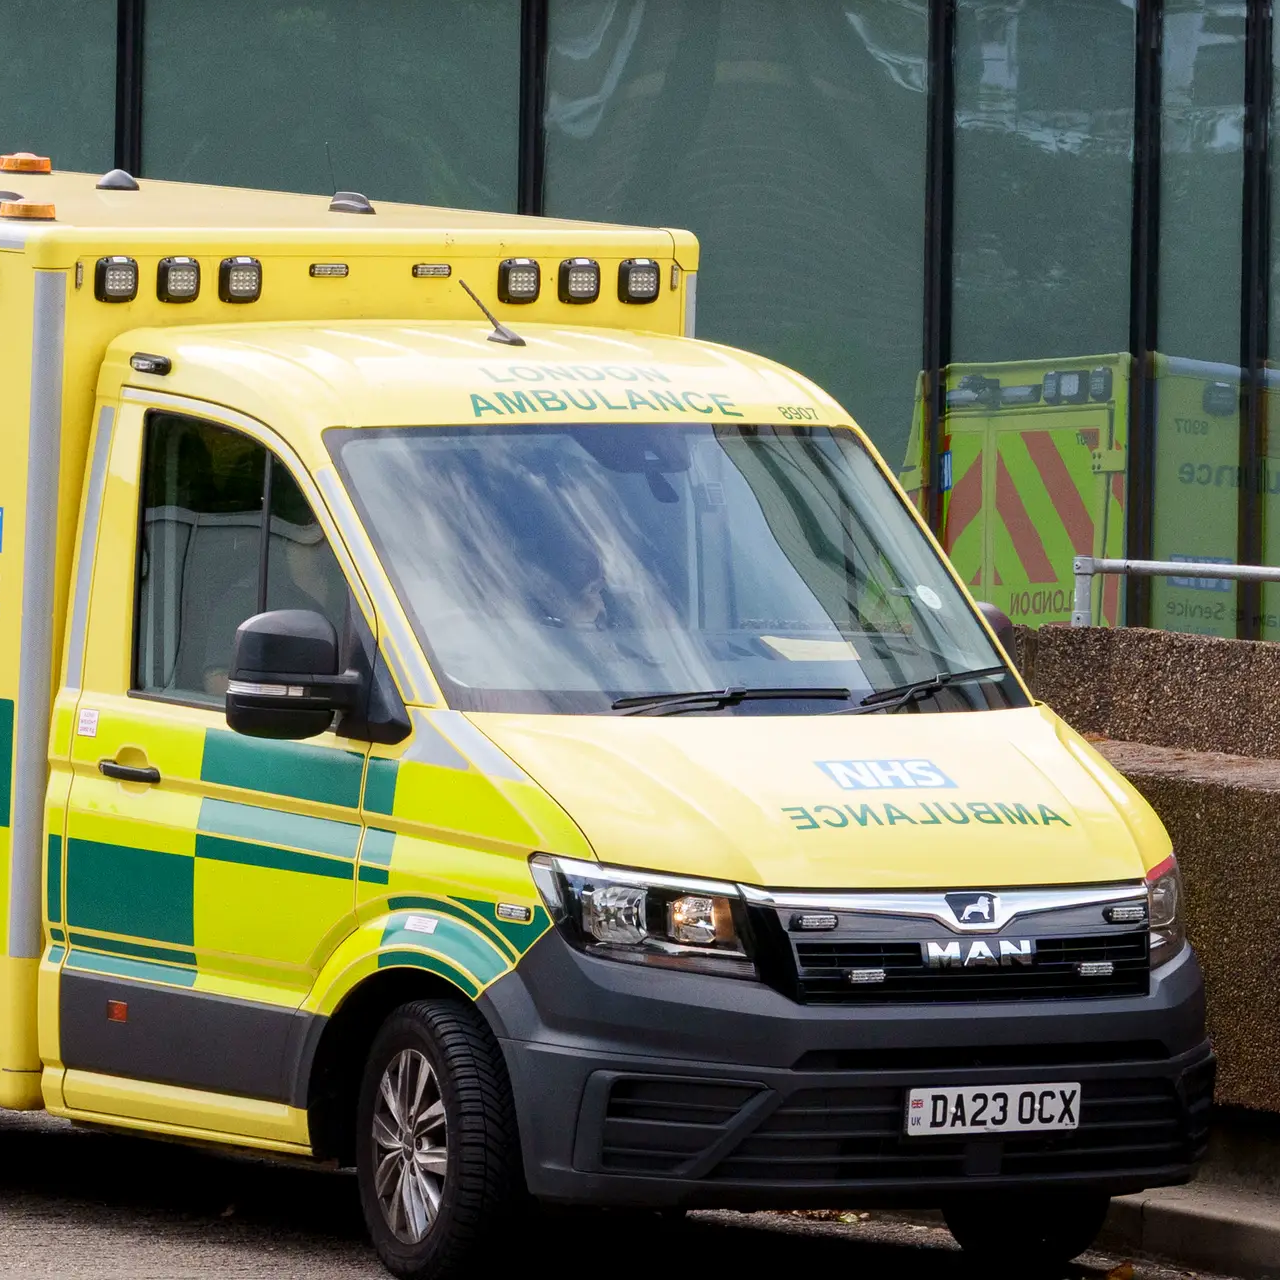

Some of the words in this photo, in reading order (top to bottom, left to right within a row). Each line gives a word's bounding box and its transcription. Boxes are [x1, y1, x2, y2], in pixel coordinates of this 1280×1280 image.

[478, 365, 671, 383] LONDON
[470, 388, 744, 418] AMBULANCE
[777, 405, 820, 421] 8907
[822, 759, 947, 789] NHS
[926, 940, 1033, 967] MAN
[911, 1116, 922, 1126] UK
[930, 1092, 1008, 1128] DA23
[1018, 1090, 1077, 1124] OCX
